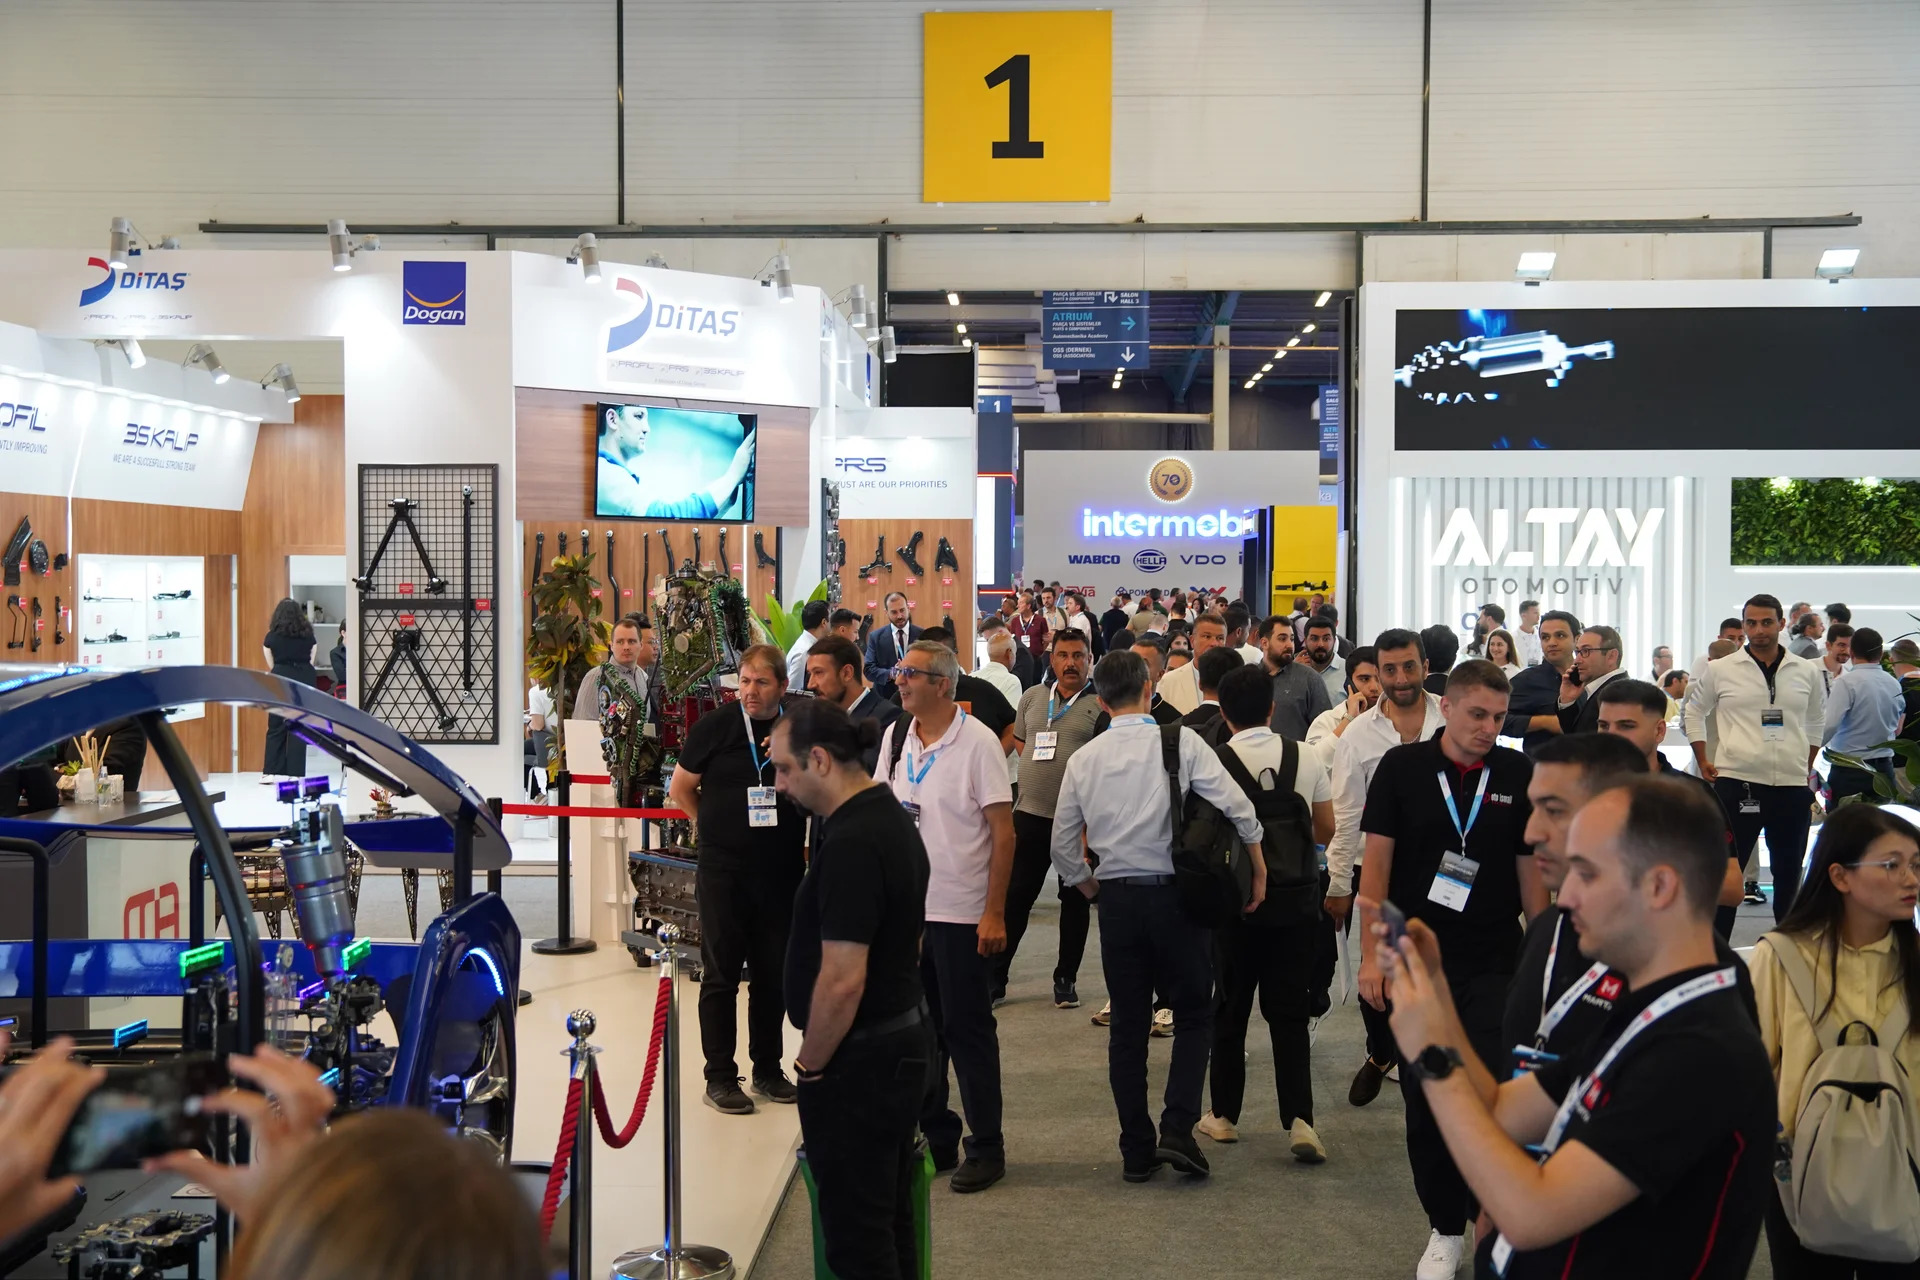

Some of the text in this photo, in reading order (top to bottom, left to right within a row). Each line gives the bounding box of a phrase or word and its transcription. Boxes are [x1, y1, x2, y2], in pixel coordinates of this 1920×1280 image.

[984, 54, 1044, 159] 1
[1052, 311, 1093, 321] ATRIUM
[993, 400, 1001, 413] 1
[113, 453, 122, 464] WE
[122, 454, 133, 465] ARE
[858, 481, 876, 489] ARE
[878, 480, 897, 489] OUR
[899, 480, 948, 489] PRIORITIES
[1432, 507, 1665, 567] ALTAY
[1068, 554, 1121, 565] WABCO
[1136, 555, 1167, 565] HELLA
[1180, 554, 1227, 565] VDO
